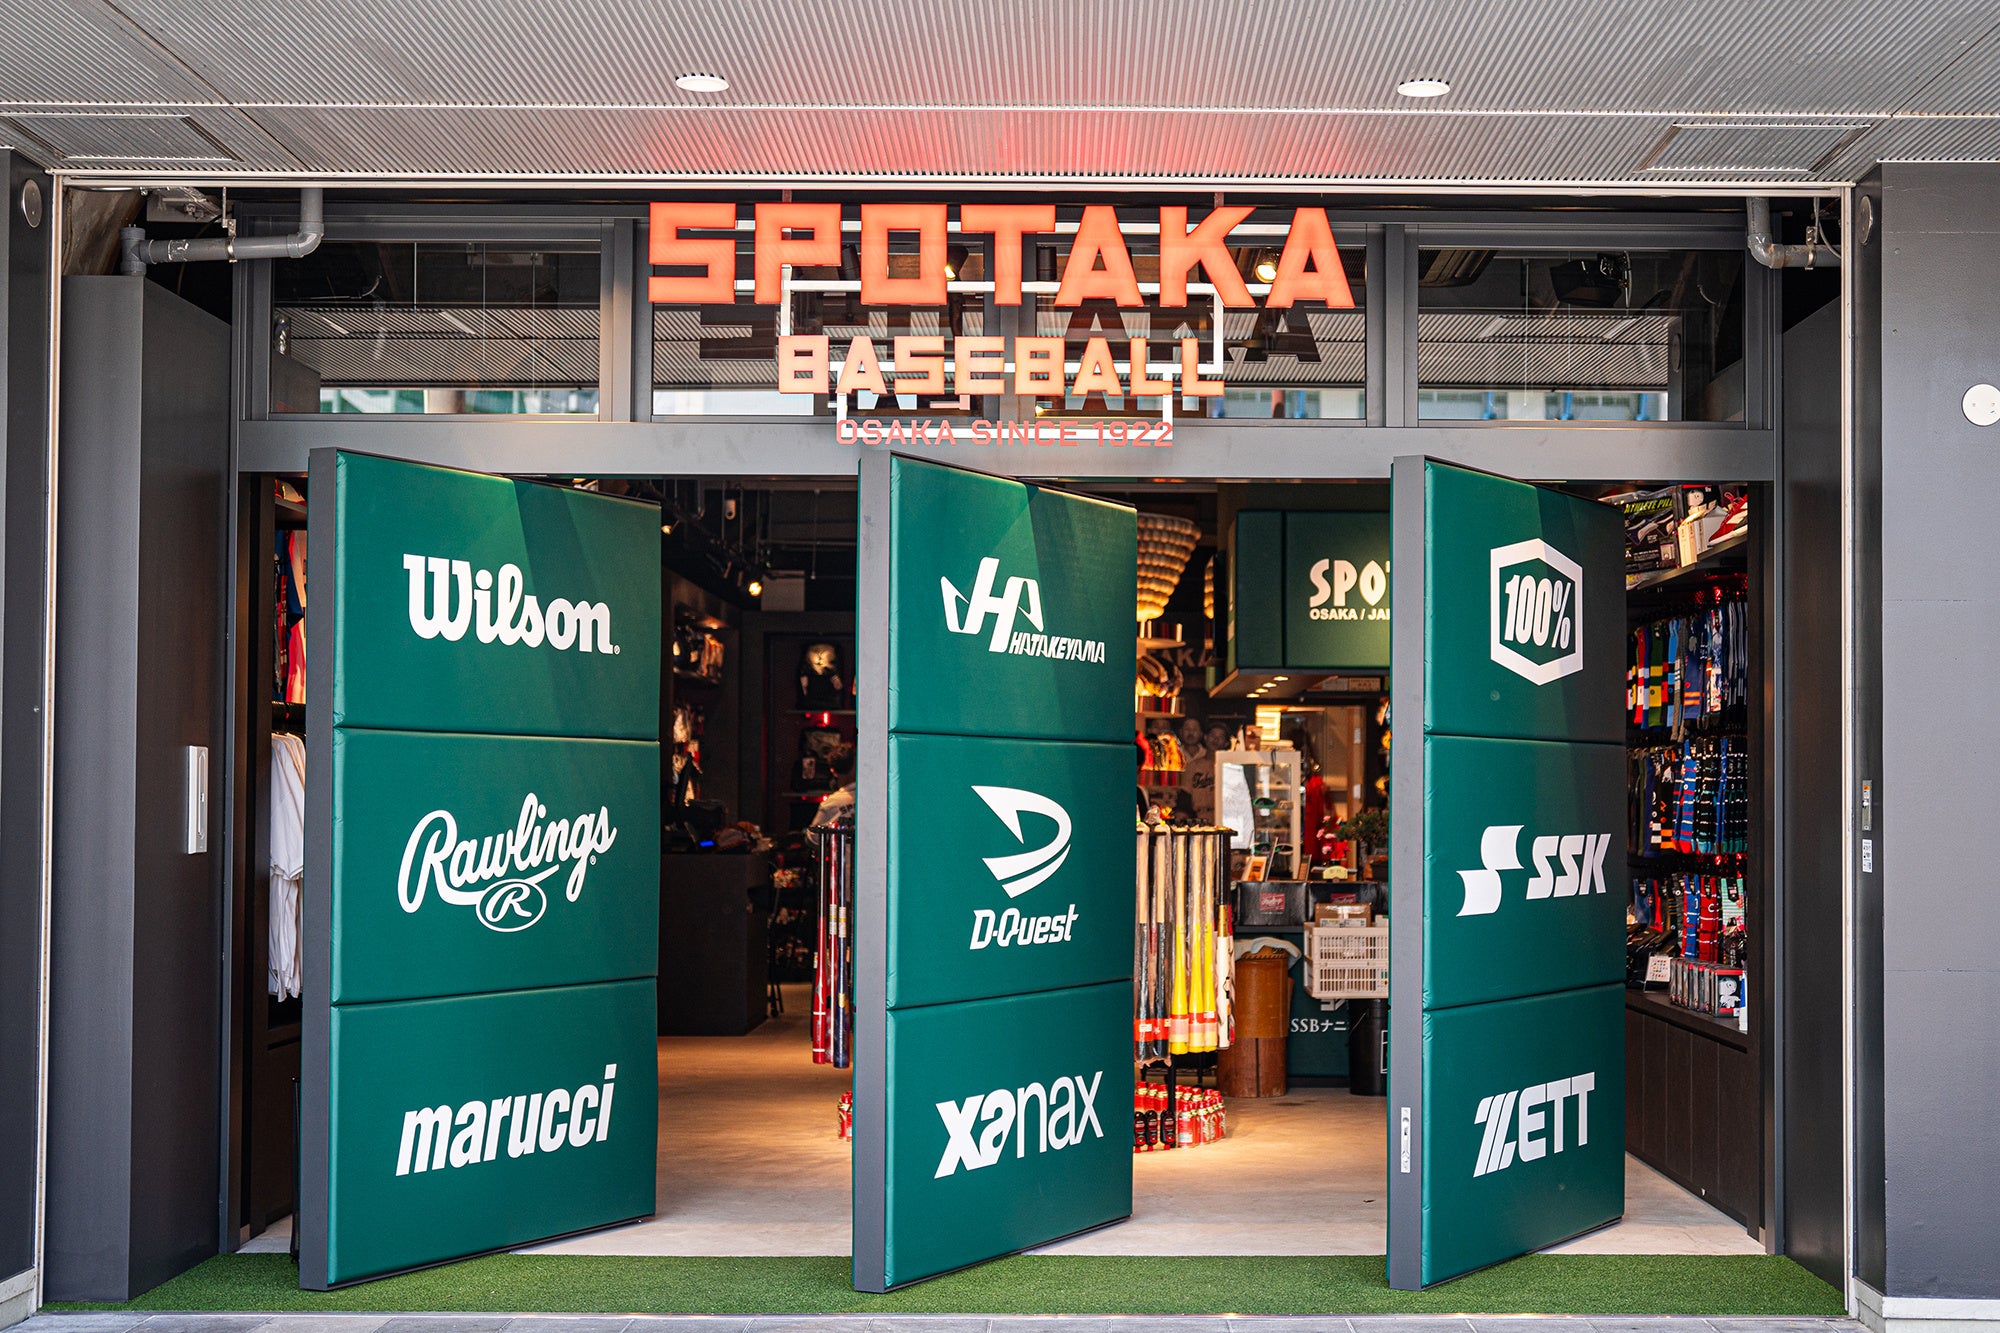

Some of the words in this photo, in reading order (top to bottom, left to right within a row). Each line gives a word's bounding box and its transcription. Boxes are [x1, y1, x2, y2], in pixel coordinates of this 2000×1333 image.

[648, 203, 1356, 309] SPOTAKA
[778, 335, 1225, 397] BASEBALL
[835, 419, 957, 446] OSAKA
[971, 420, 1079, 447] SINCE
[1092, 420, 1174, 447] 1922
[403, 553, 614, 655] Wilson
[1309, 558, 1390, 608] SPO
[1309, 608, 1358, 620] OSAKA
[1504, 574, 1572, 650] 100%
[1008, 631, 1106, 664] HATAKEYAMA
[397, 792, 617, 913] Rawlings
[1526, 833, 1611, 900] SSK
[969, 903, 1080, 950] D-Quest
[395, 1063, 617, 1177] marucci
[933, 1071, 1104, 1179] xanax
[1473, 1072, 1595, 1178] ZETT
